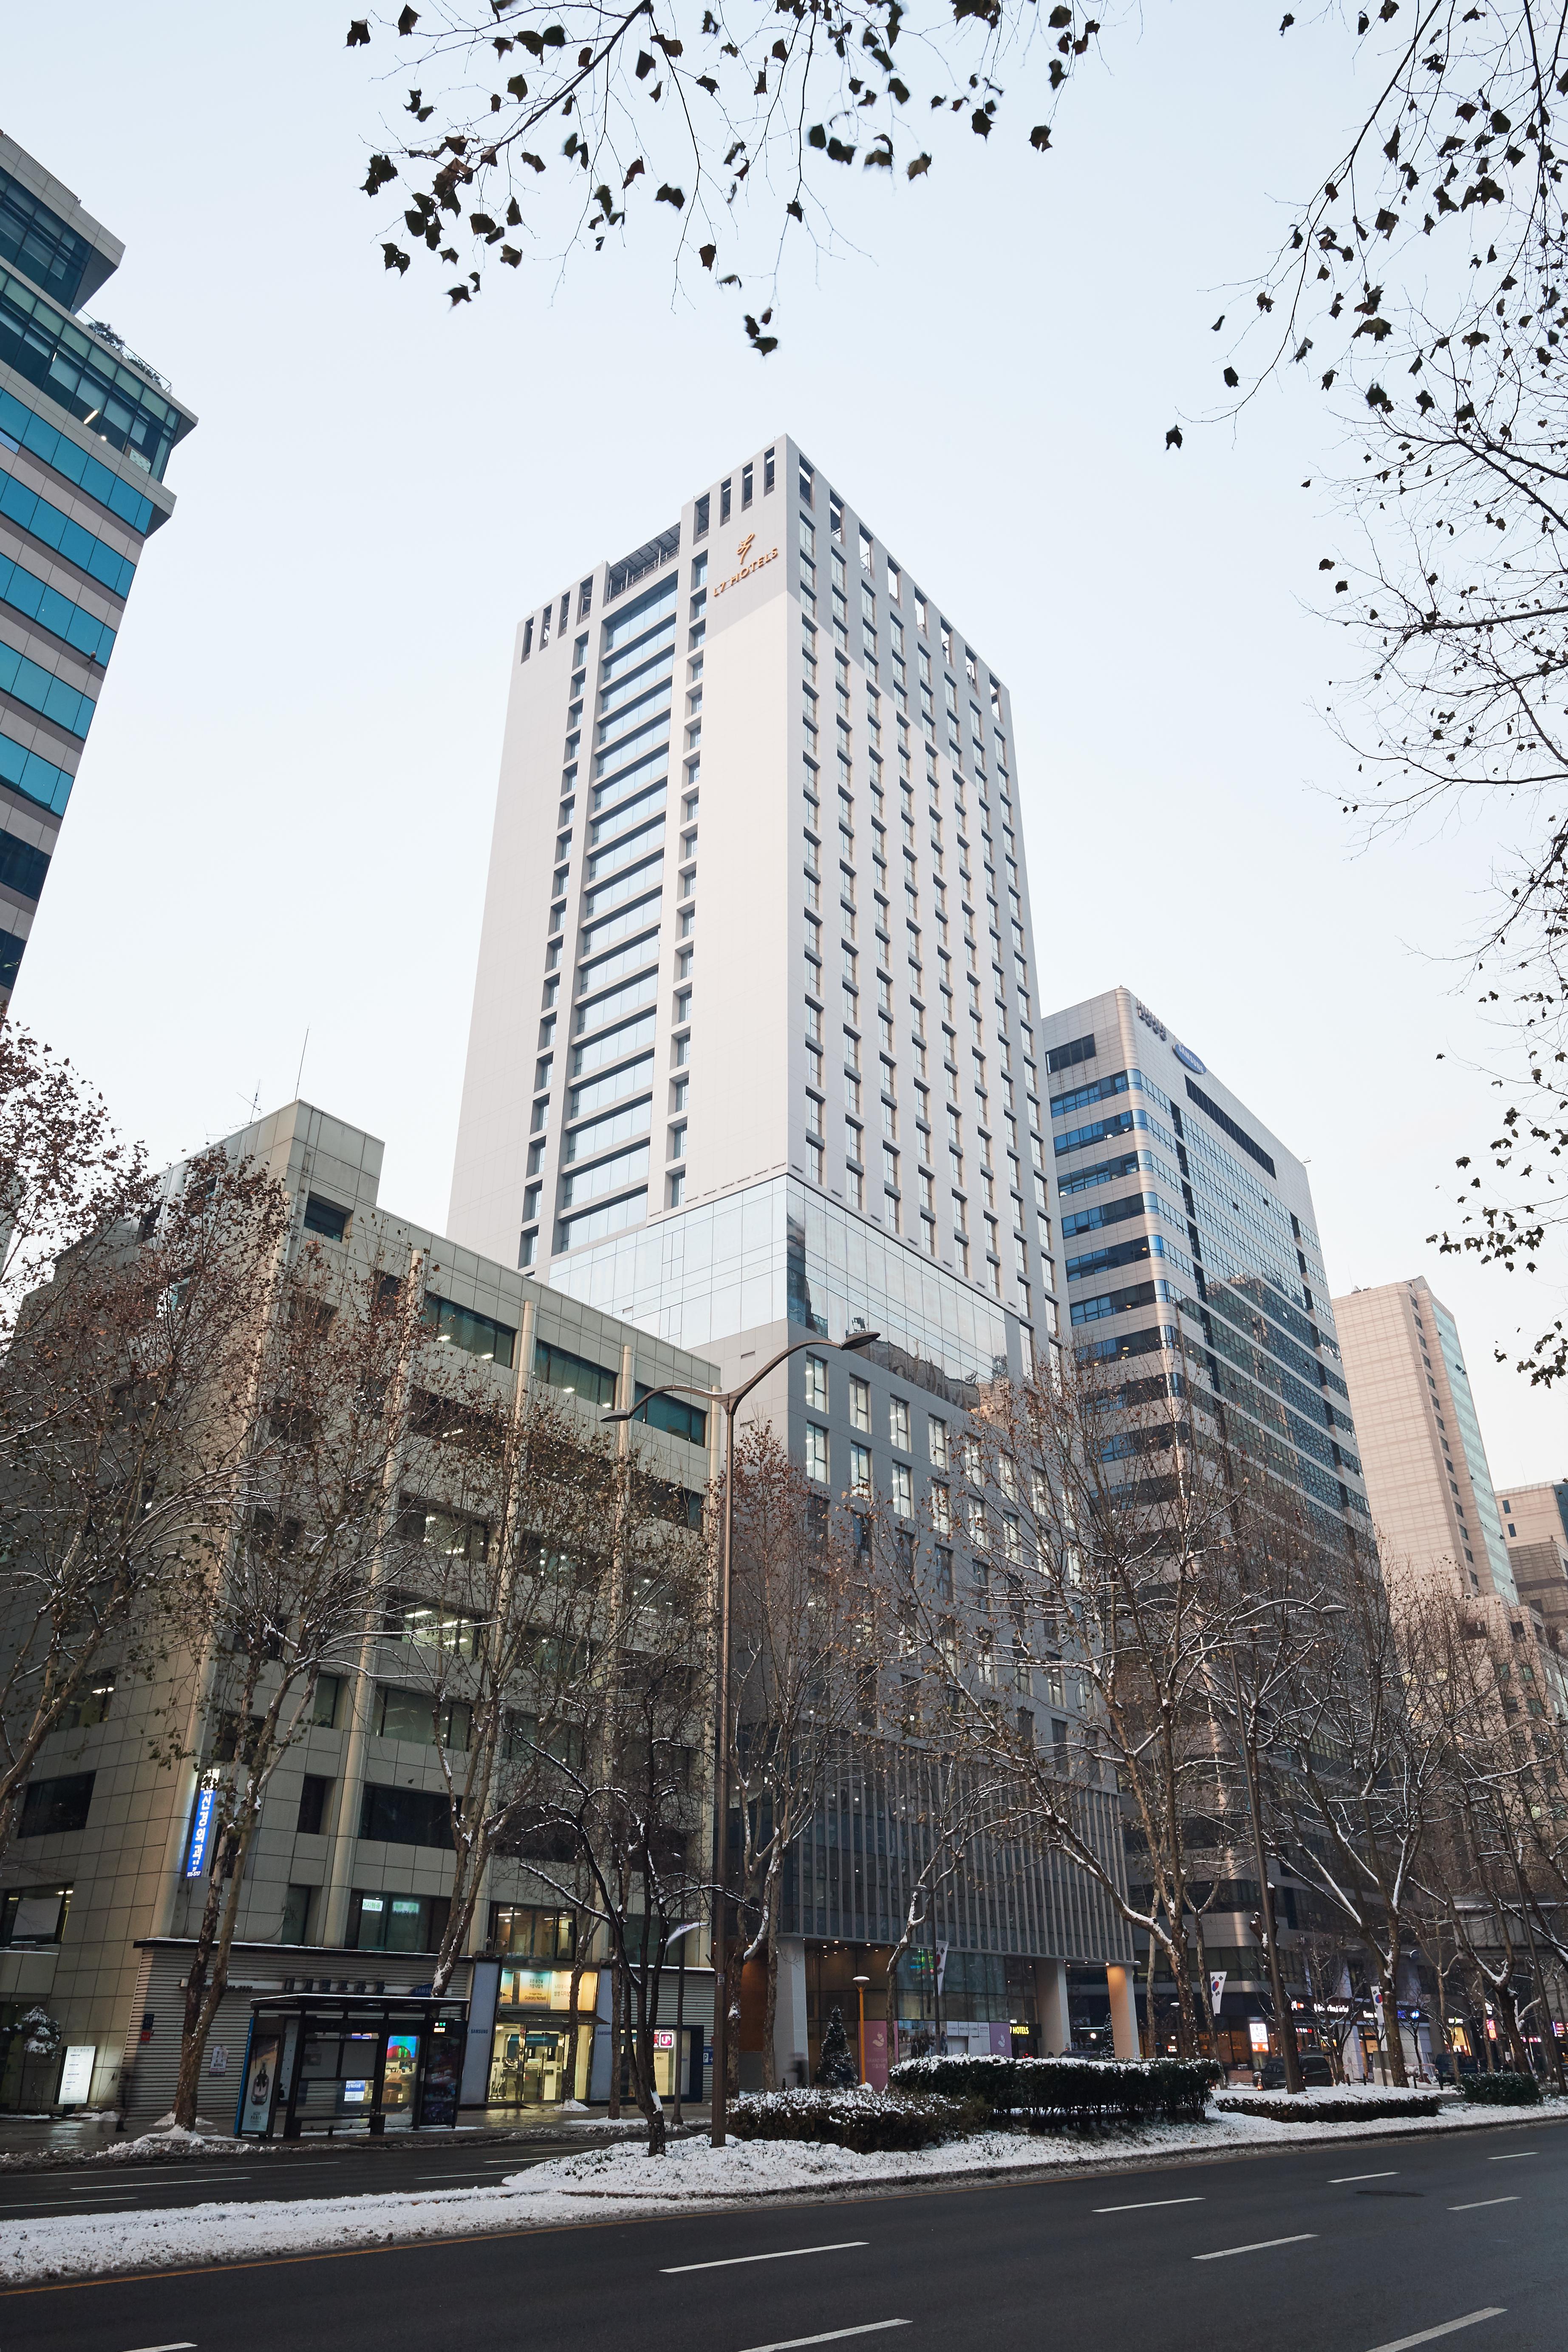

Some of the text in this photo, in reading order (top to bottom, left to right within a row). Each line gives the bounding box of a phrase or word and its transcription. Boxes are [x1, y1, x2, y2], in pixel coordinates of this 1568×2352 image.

[713, 547, 778, 597] L7 HOTELS
[1178, 1044, 1204, 1073] SAMSUNG
[192, 1794, 212, 1860] 신경외과
[283, 1978, 385, 1994] 디지털프라자
[1013, 2026, 1029, 2035] HOTELS
